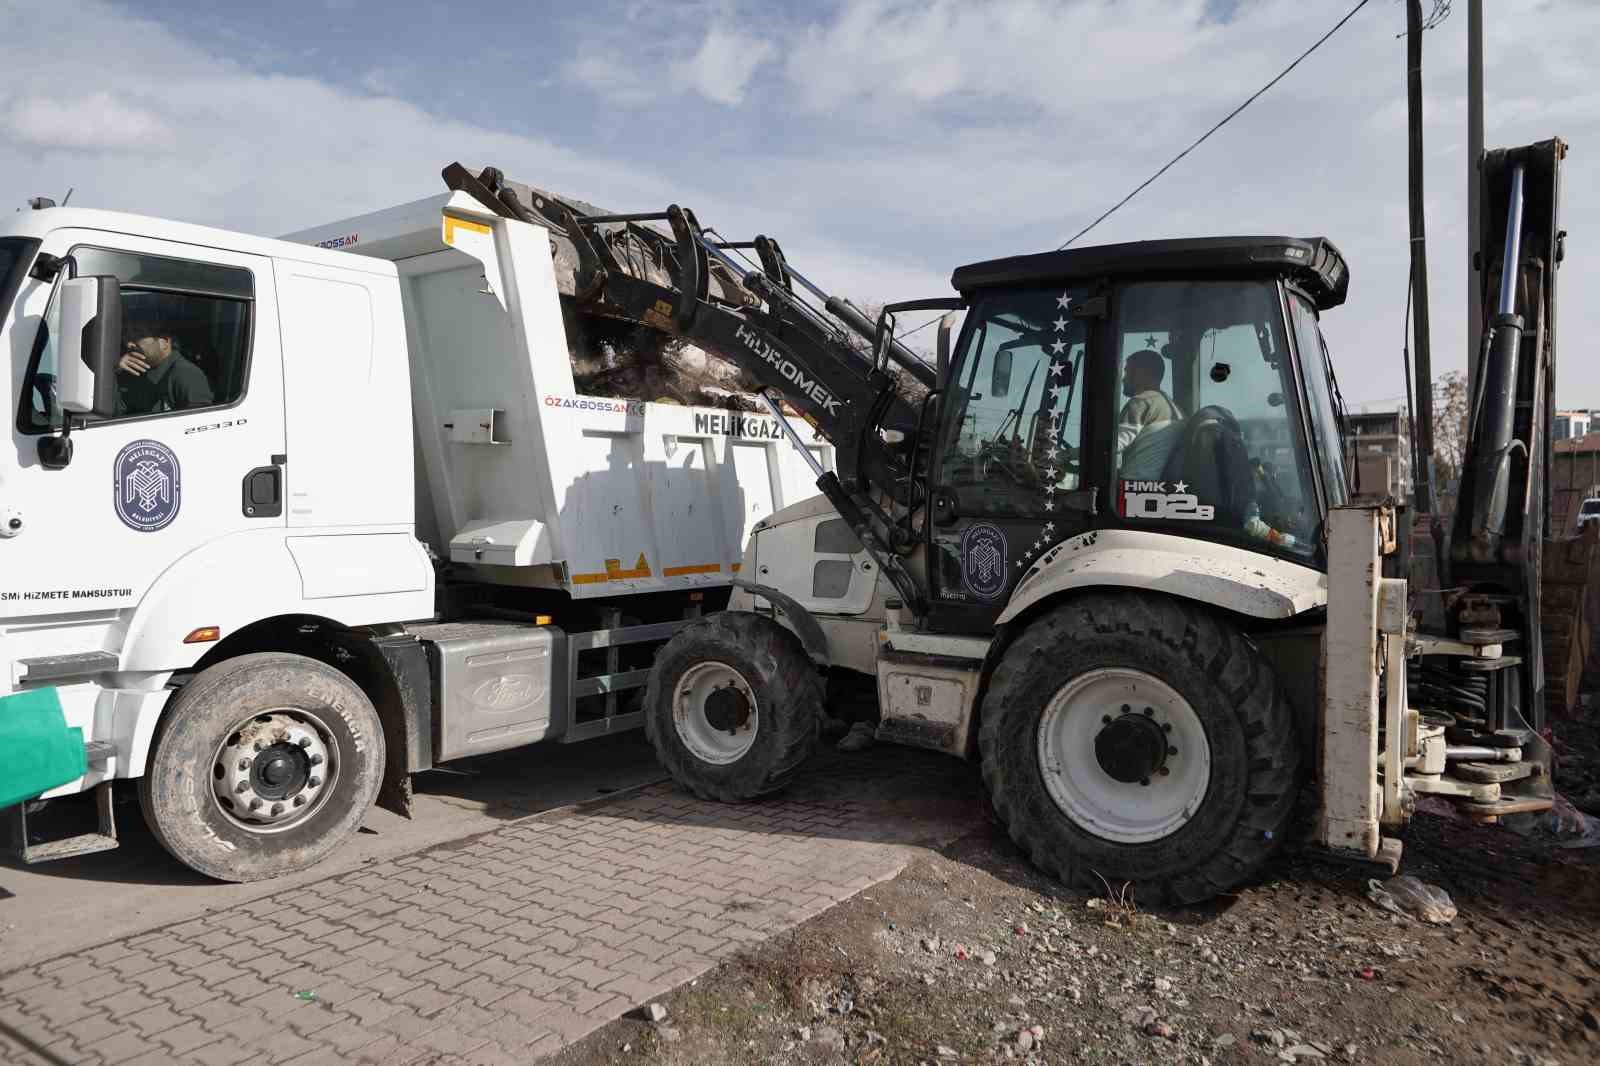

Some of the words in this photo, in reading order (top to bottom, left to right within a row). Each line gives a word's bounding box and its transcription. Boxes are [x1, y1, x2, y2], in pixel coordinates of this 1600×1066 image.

[315, 233, 359, 249] BOSSAN
[1125, 481, 1167, 492] HMK
[72, 588, 132, 599] MAHSUSTUR
